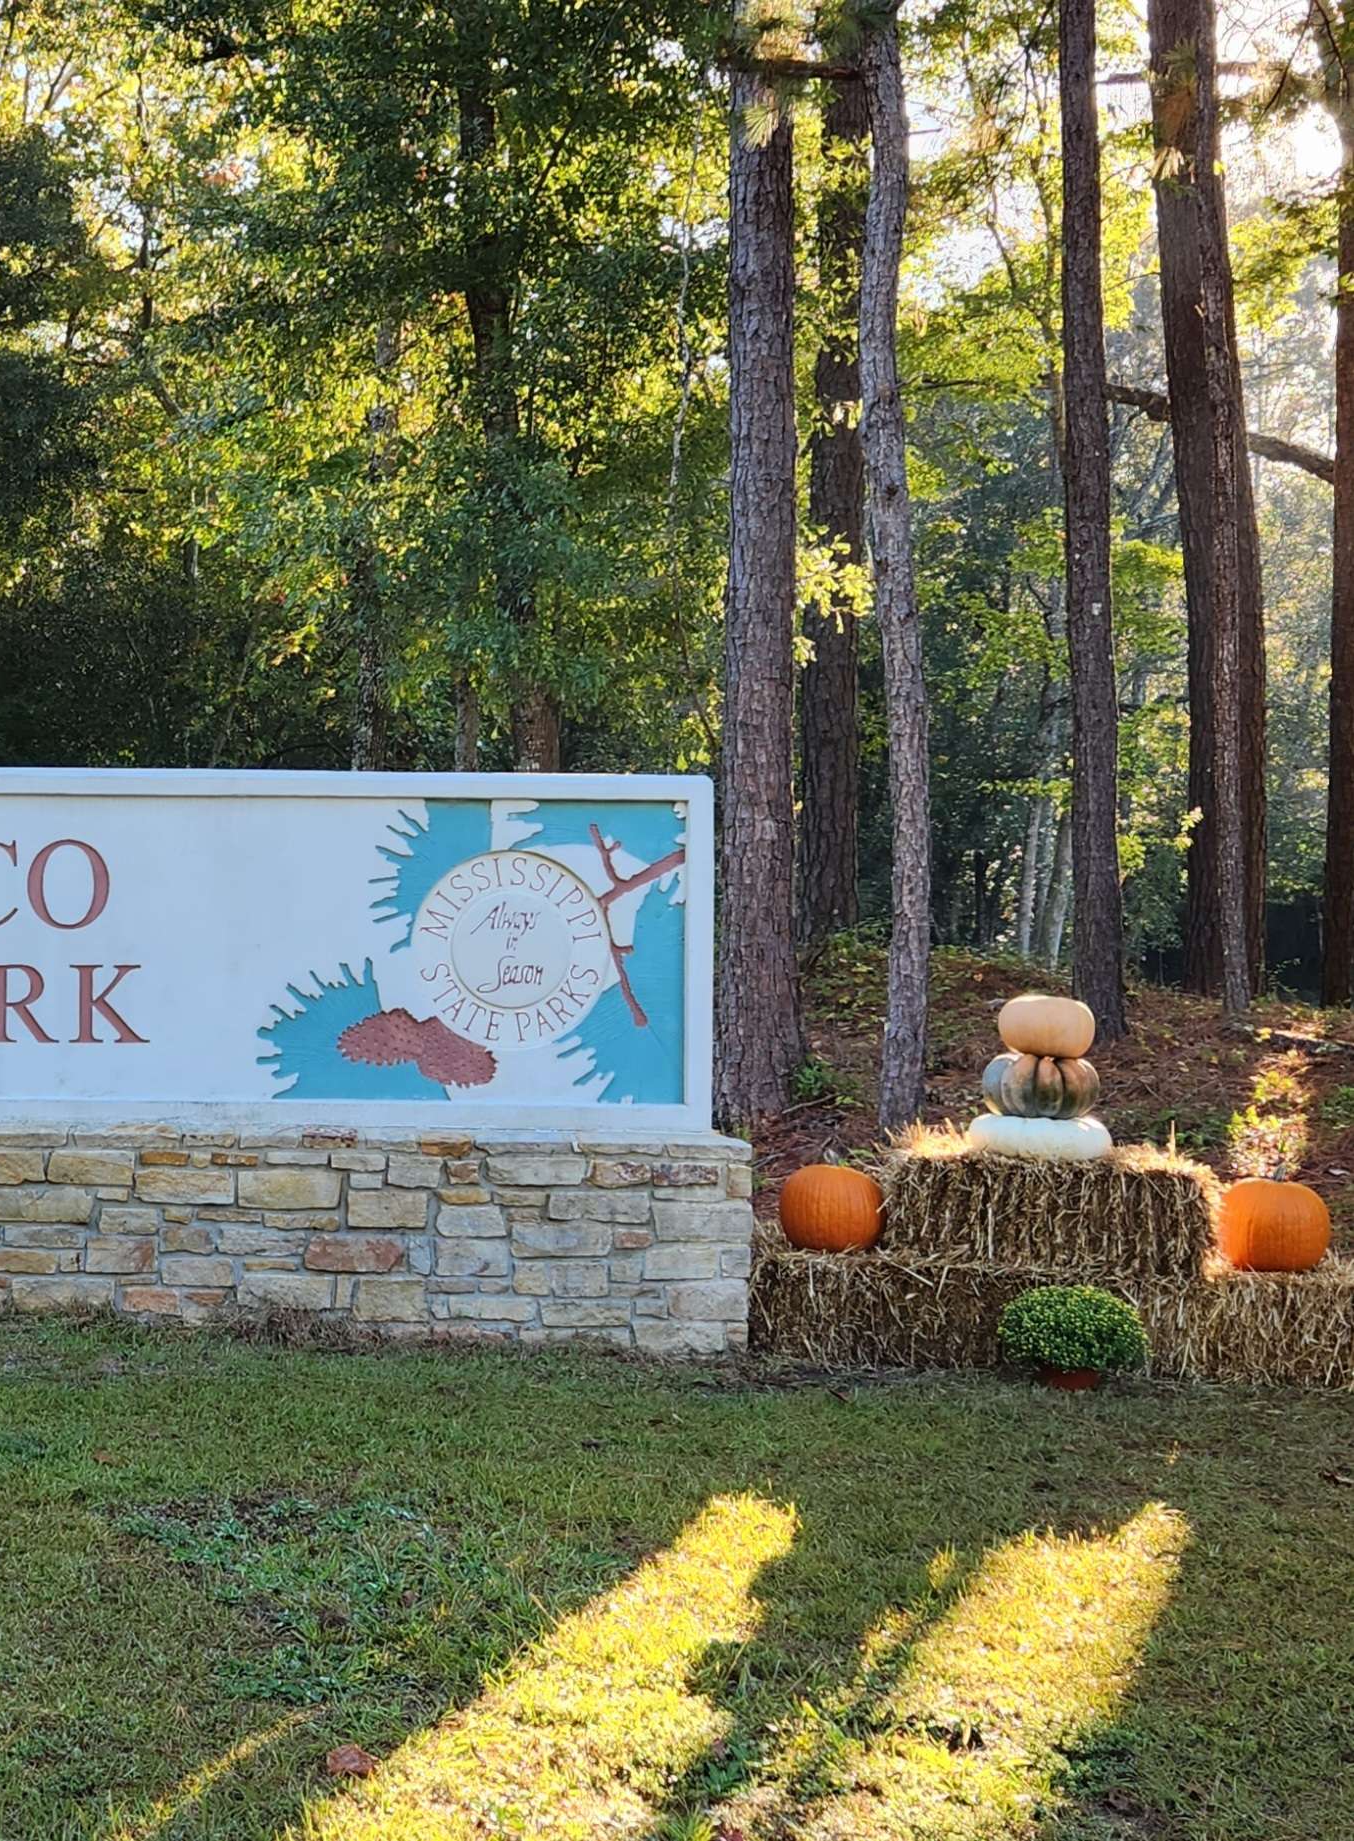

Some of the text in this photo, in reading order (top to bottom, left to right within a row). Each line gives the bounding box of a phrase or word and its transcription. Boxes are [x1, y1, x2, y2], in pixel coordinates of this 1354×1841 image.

[420, 857, 602, 944] MISSISSIPPI
[470, 901, 541, 935] Always
[420, 962, 600, 1043] STATE PARKS
[476, 956, 544, 993] Season
